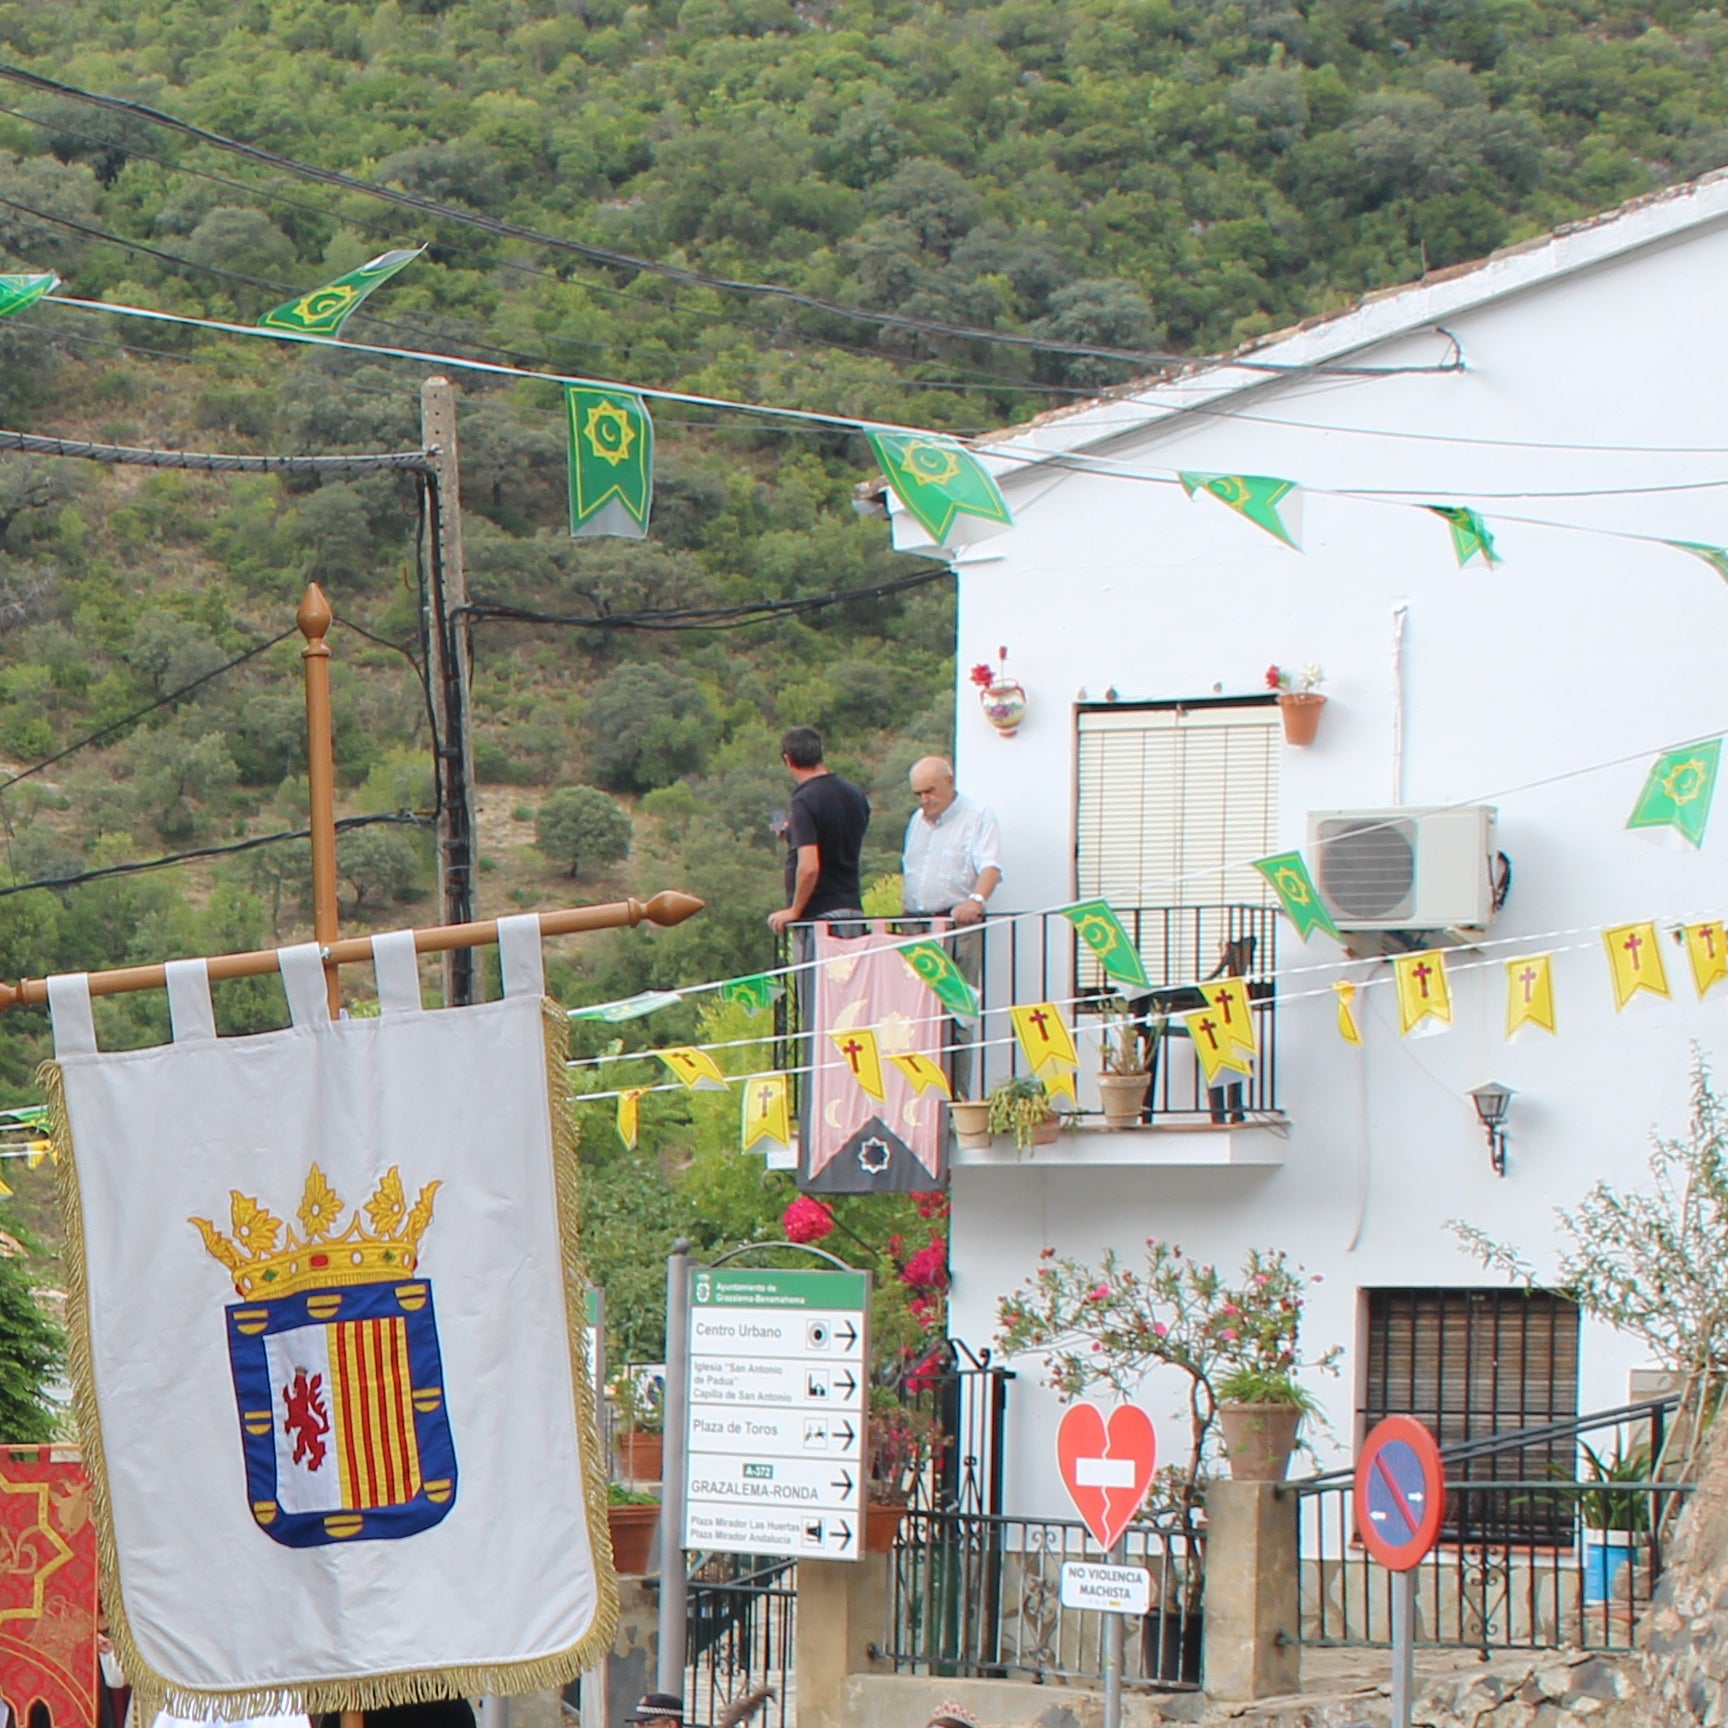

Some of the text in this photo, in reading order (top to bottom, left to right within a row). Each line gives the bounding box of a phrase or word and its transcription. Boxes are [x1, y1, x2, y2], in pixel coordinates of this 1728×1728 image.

[716, 1282, 776, 1292] Ayuntamiento de
[696, 1322, 782, 1338] Centro Urbano
[694, 1361, 722, 1372] Iglesia
[748, 1363, 782, 1374] Antonio
[694, 1375, 704, 1384] de
[693, 1387, 792, 1402] Capilla de San Antonio
[692, 1419, 778, 1435] Plaza de Toros
[745, 1465, 770, 1477] A-372
[691, 1479, 818, 1499] GRAZALEMA-RONDA
[690, 1515, 800, 1531] Plaza Mirador Las Huertas
[690, 1528, 712, 1538] Plaza
[714, 1530, 746, 1541] Mirador
[1069, 1567, 1143, 1584] NO VIOLENCIA
[1080, 1584, 1131, 1599] MACHISTA
